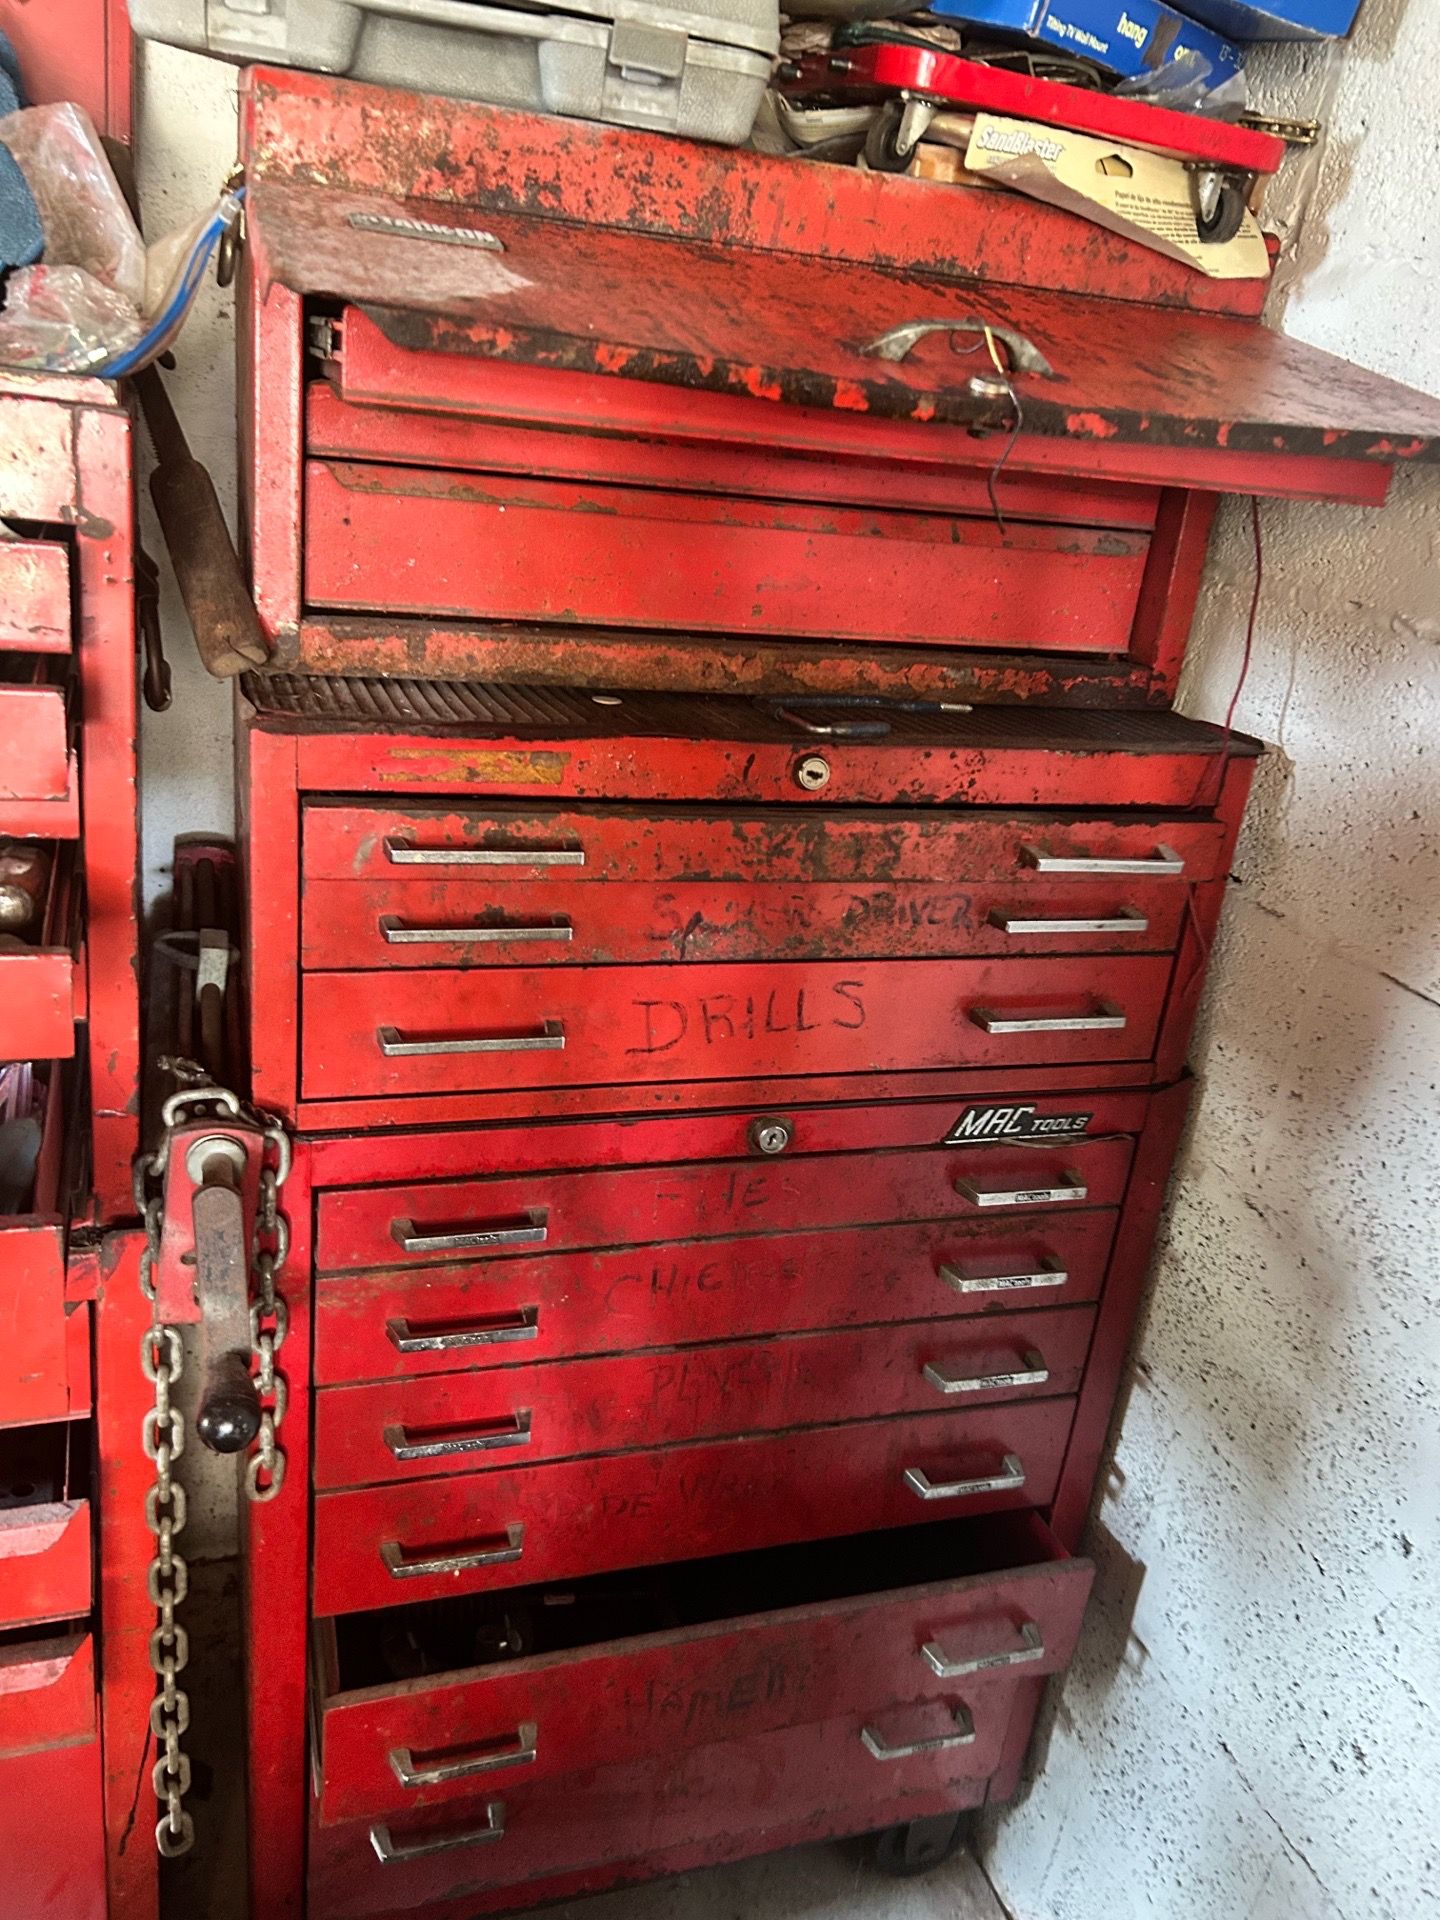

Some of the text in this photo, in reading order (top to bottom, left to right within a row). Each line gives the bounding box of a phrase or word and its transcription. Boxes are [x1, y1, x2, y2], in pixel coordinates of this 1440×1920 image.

[1116, 12, 1148, 48] hang
[625, 980, 867, 1056] DRILLS
[955, 1107, 1088, 1137] MAC TOOLS
